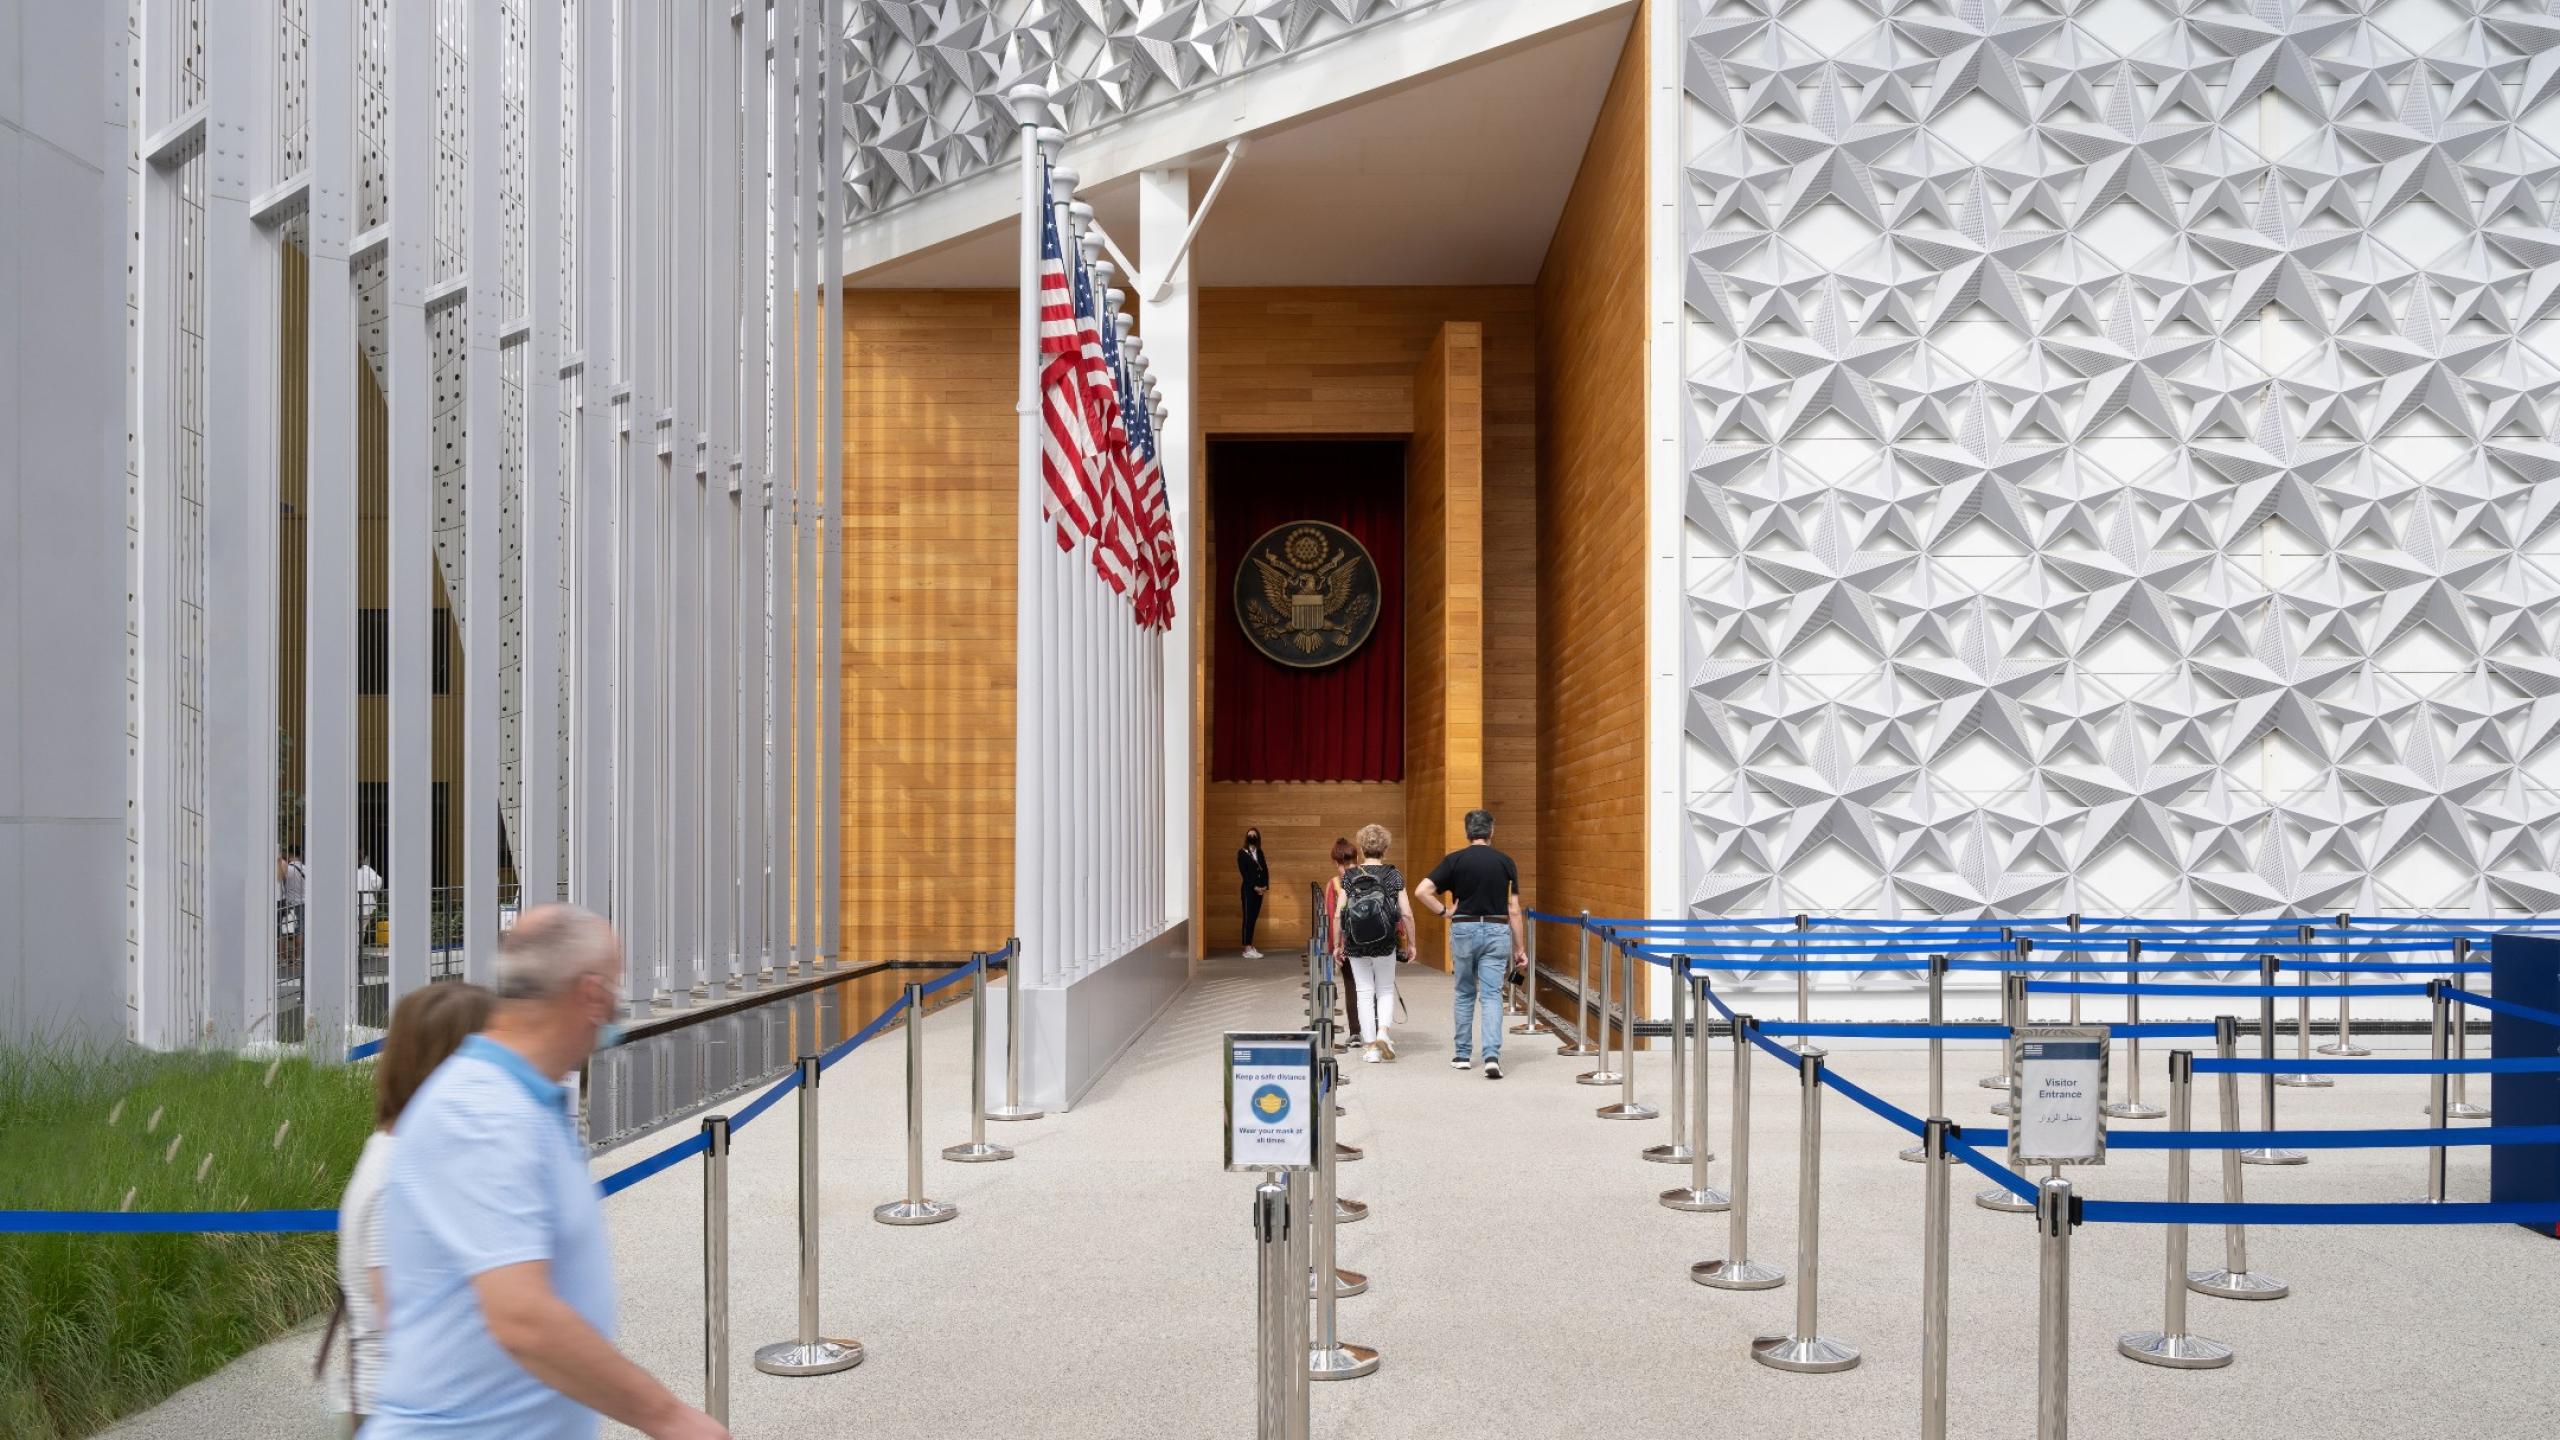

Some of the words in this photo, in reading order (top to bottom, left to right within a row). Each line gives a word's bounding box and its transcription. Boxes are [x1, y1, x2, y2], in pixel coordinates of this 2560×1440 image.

[1236, 1073, 1253, 1081] Keep
[1260, 1072, 1276, 1080] safe
[1277, 1072, 1306, 1080] distance
[2045, 1078, 2078, 1086] Visitor
[2039, 1090, 2082, 1098] Entrance
